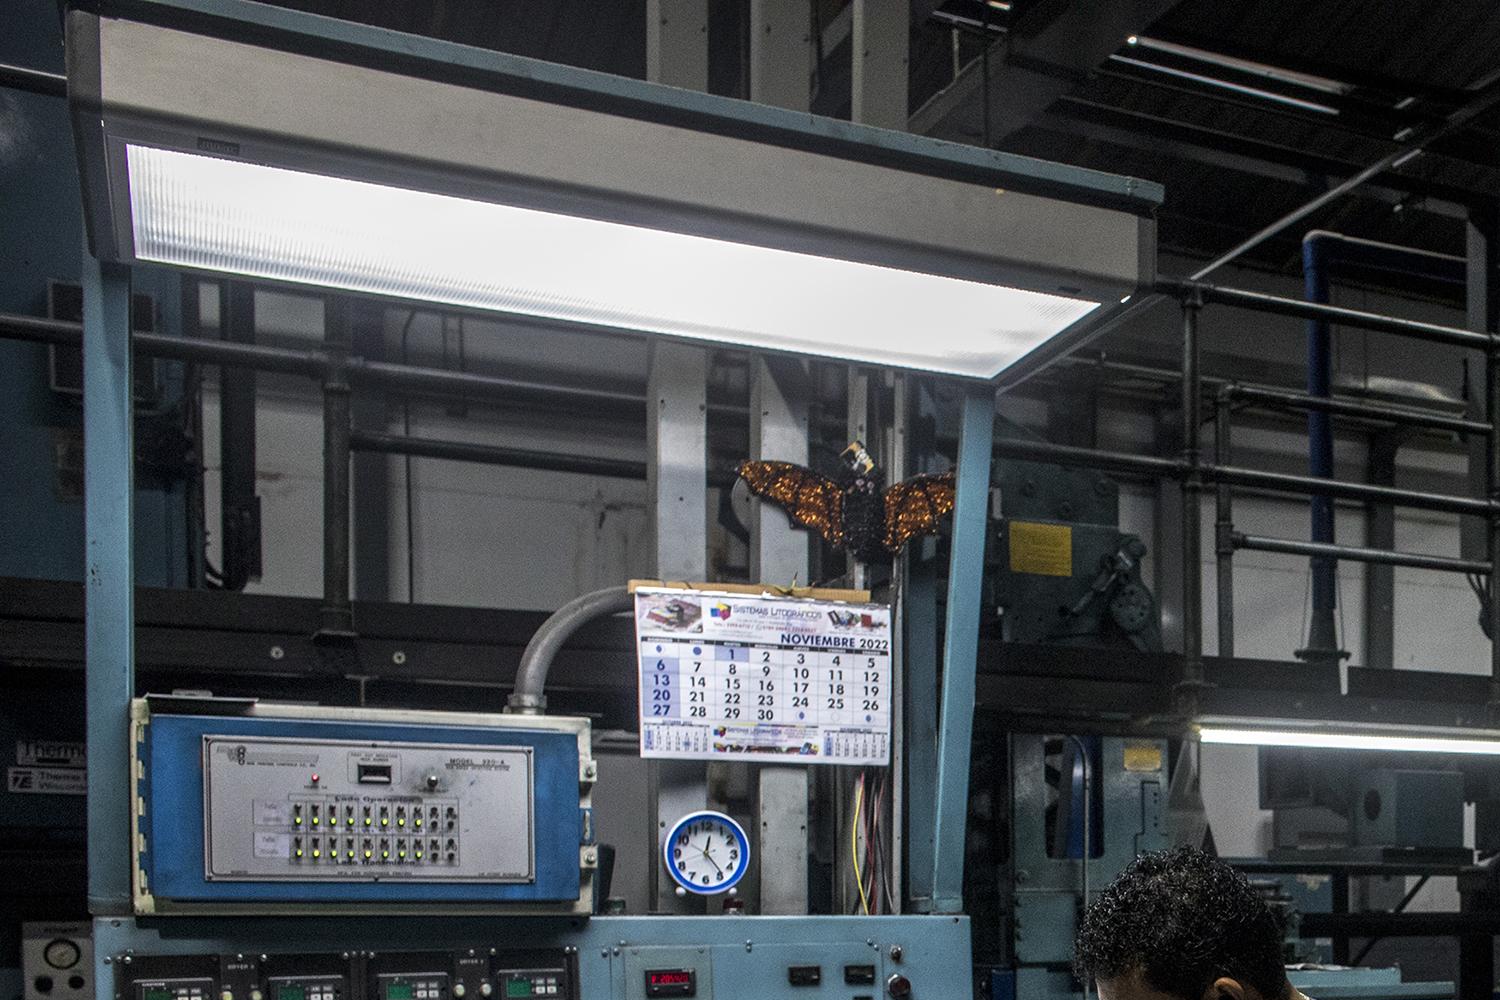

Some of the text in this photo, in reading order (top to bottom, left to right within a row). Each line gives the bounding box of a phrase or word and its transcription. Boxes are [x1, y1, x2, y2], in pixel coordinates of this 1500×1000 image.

[781, 633, 855, 648] NOVIEMBRE
[860, 638, 888, 650] 2022
[762, 651, 771, 663] 2
[796, 653, 805, 665] 3
[832, 655, 841, 666] 4
[867, 657, 875, 669] 5
[656, 659, 879, 683] 6 7 8 9 10 11 12
[653, 674, 879, 697] 13 14 15 16 17 18 19
[653, 689, 879, 711] 20 21 22 23 24 25 26
[653, 704, 774, 721] 27 28 29 30
[687, 823, 698, 836] 11
[701, 820, 713, 832] 12
[677, 833, 690, 846] 10
[725, 834, 734, 845] 2
[673, 848, 682, 860] 9
[729, 849, 738, 860] 3
[677, 860, 686, 871] 8
[726, 861, 734, 871] 4
[688, 871, 697, 880] 7
[701, 877, 710, 885] 6
